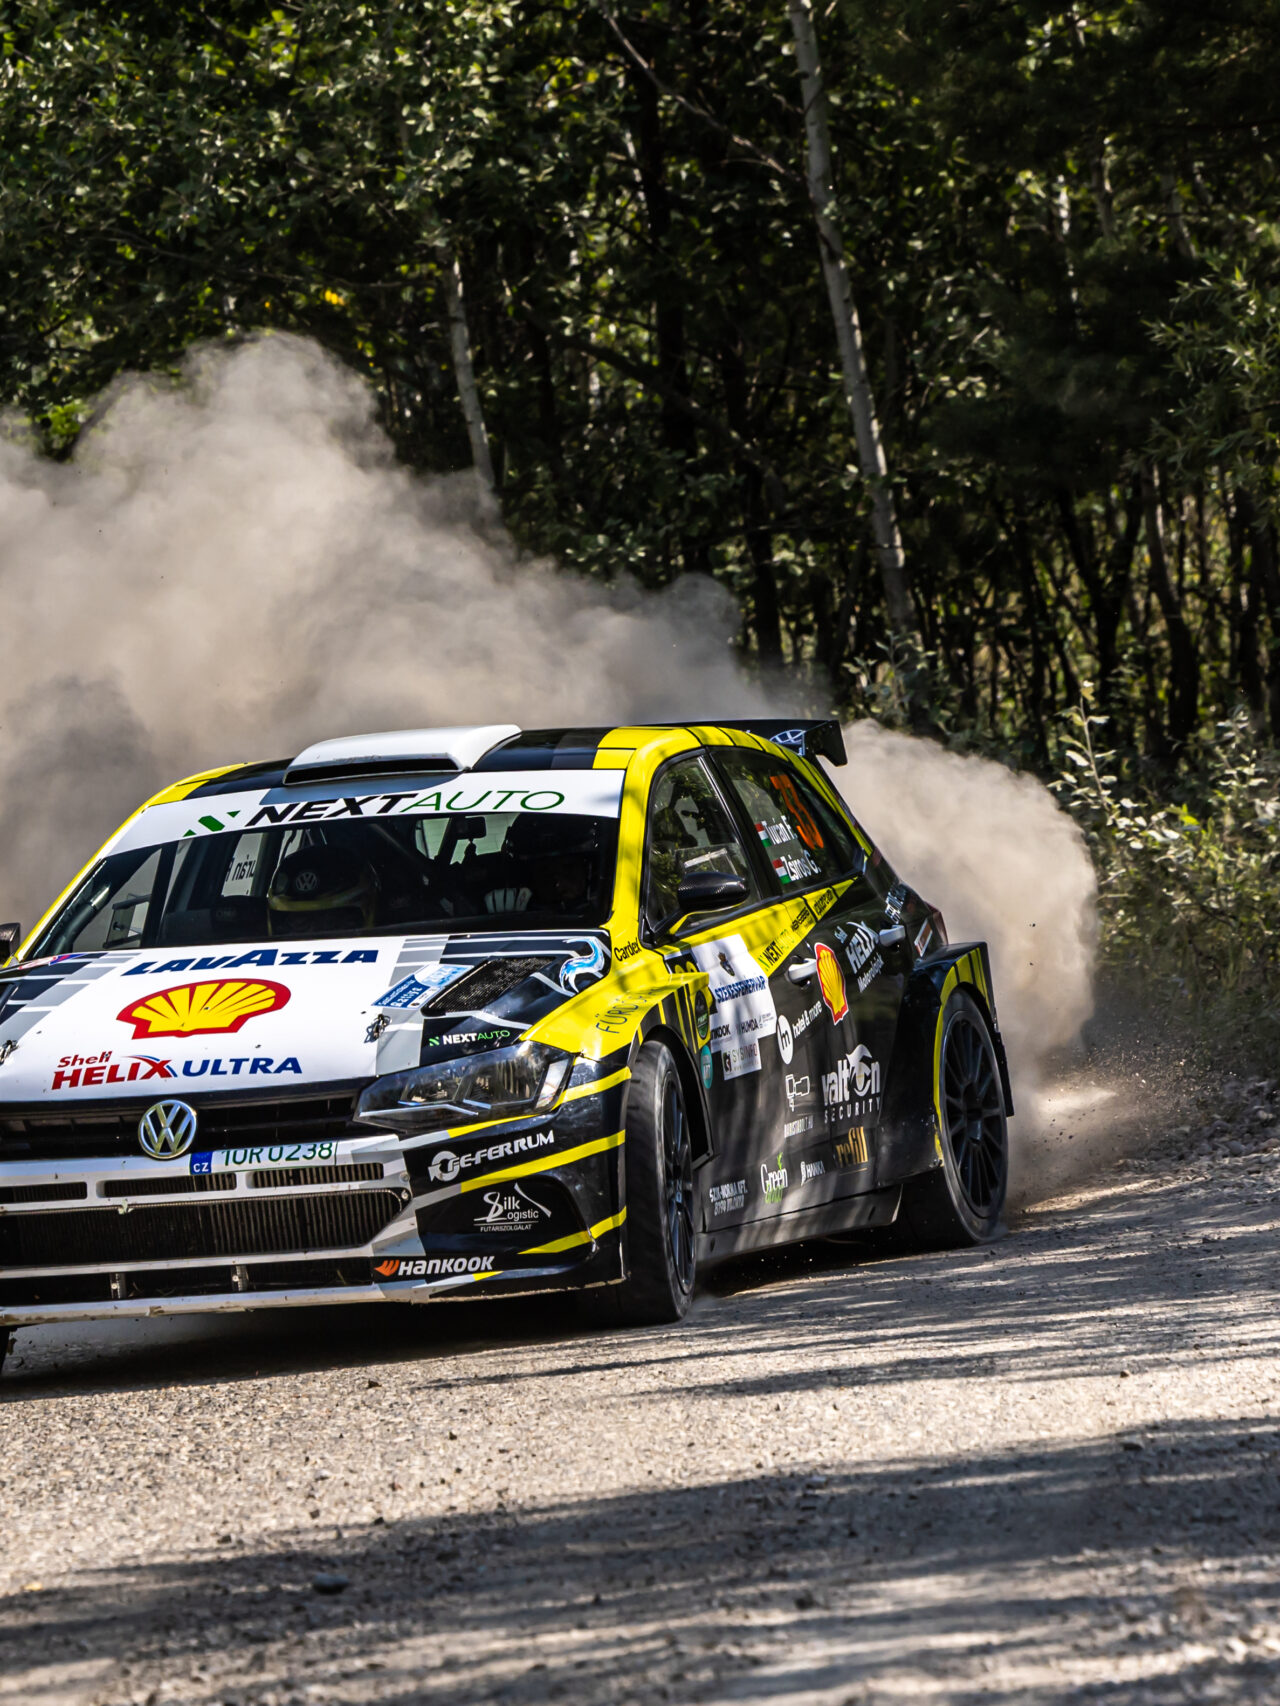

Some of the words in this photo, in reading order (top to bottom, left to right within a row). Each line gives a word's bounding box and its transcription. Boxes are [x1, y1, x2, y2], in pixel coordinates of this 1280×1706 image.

[245, 790, 564, 827] NEXTAUTO
[614, 938, 642, 961] Cardex
[845, 920, 879, 974] HELIX
[120, 949, 378, 976] LAVAZZA
[442, 1030, 510, 1045] NEXTAUTO
[51, 1056, 177, 1090] HELIX
[182, 1057, 302, 1077] ULTRA
[57, 1051, 113, 1068] Shell
[824, 1097, 881, 1124] SECURITY
[835, 1126, 868, 1168] refill
[193, 1162, 209, 1173] CZ
[760, 1163, 789, 1195] Green
[481, 1191, 521, 1219] Silk
